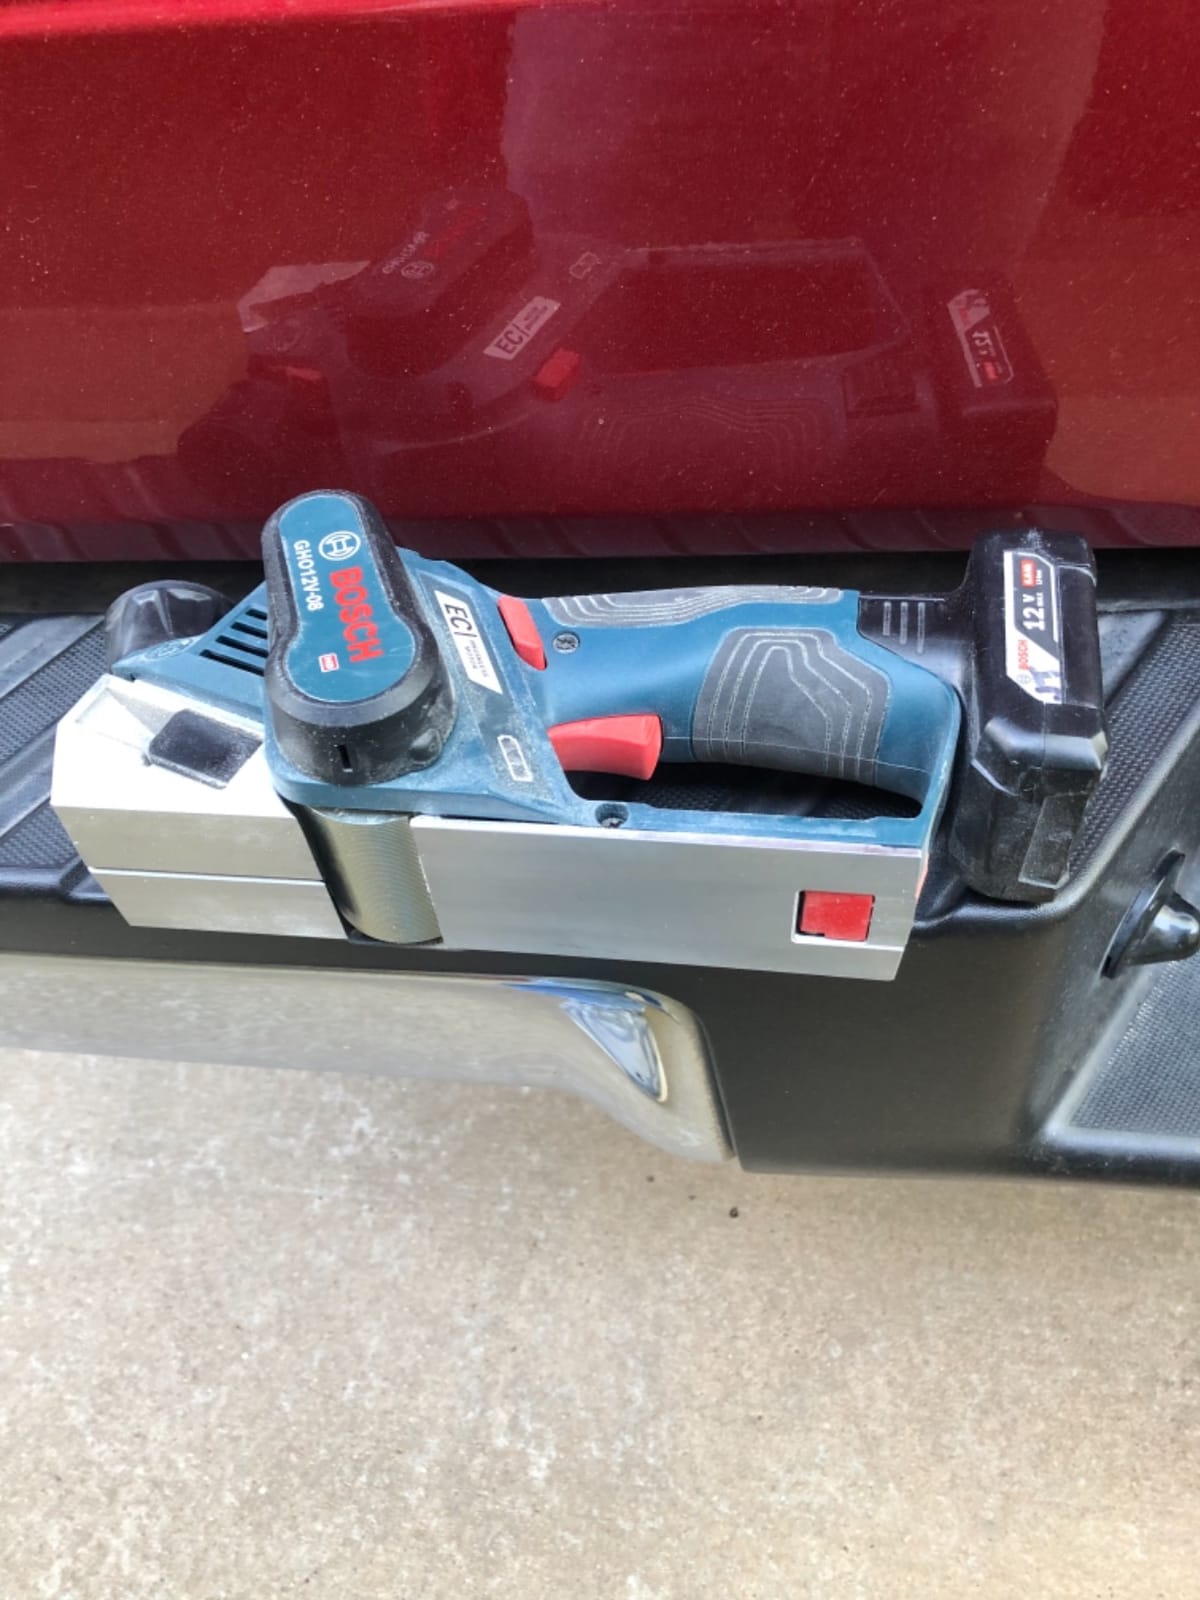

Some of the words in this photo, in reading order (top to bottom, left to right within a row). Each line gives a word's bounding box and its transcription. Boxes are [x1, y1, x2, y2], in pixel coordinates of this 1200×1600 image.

[294, 539, 324, 612] GHO12V-08
[330, 567, 383, 662] BOSCH
[1018, 639, 1029, 670] BOSCH
